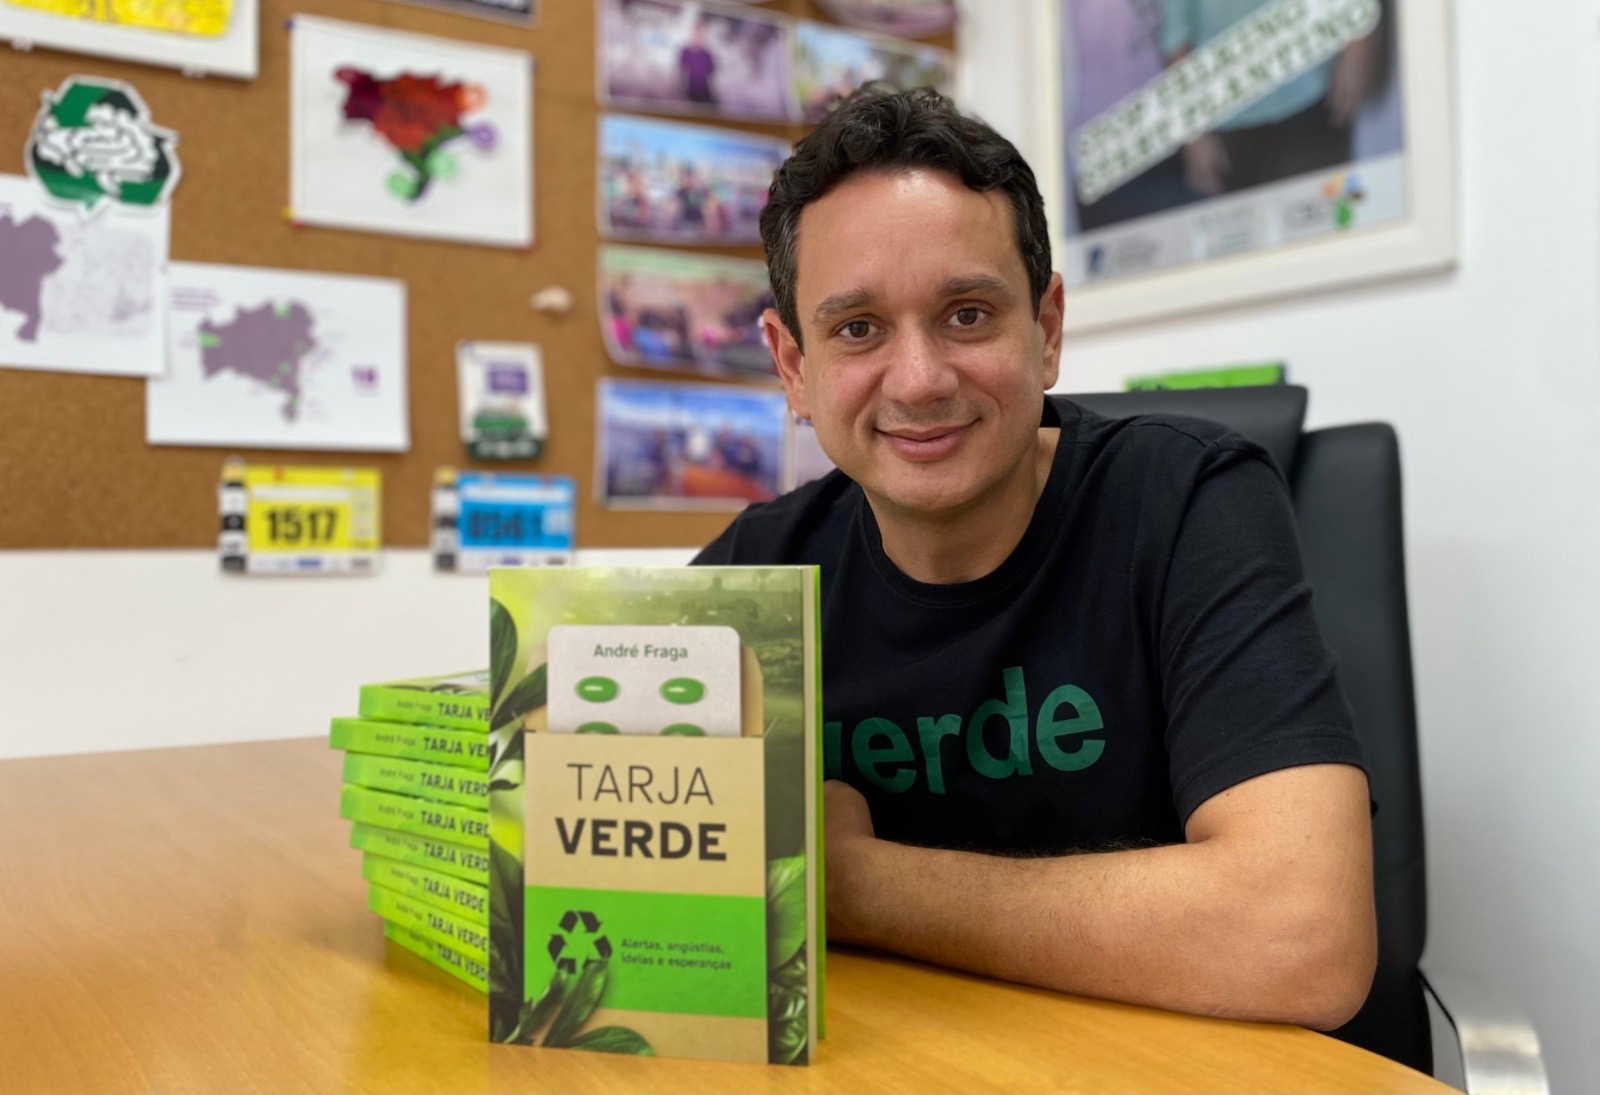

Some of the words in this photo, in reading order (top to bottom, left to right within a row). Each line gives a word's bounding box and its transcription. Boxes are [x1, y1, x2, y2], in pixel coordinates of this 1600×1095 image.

[1073, 122, 1170, 192] START
[1176, 0, 1370, 130] PLANTING
[1074, 98, 1150, 157] STOP
[264, 507, 338, 544] 1517
[593, 643, 640, 659] André
[643, 644, 689, 662] Fraga
[438, 702, 473, 719] TARJA
[423, 737, 463, 755] TARJA
[421, 772, 454, 791] TARJA
[458, 780, 488, 797] VERD
[565, 763, 714, 806] TARJA
[421, 811, 455, 830] TARJA
[555, 817, 727, 861] VERDE
[424, 843, 456, 863] TARJA
[460, 853, 489, 872] VERD
[424, 877, 451, 899] TARJA
[454, 888, 485, 913] VERDE
[428, 913, 454, 936] TARJA
[437, 944, 462, 967] TARJA
[668, 957, 732, 971] esperanças
